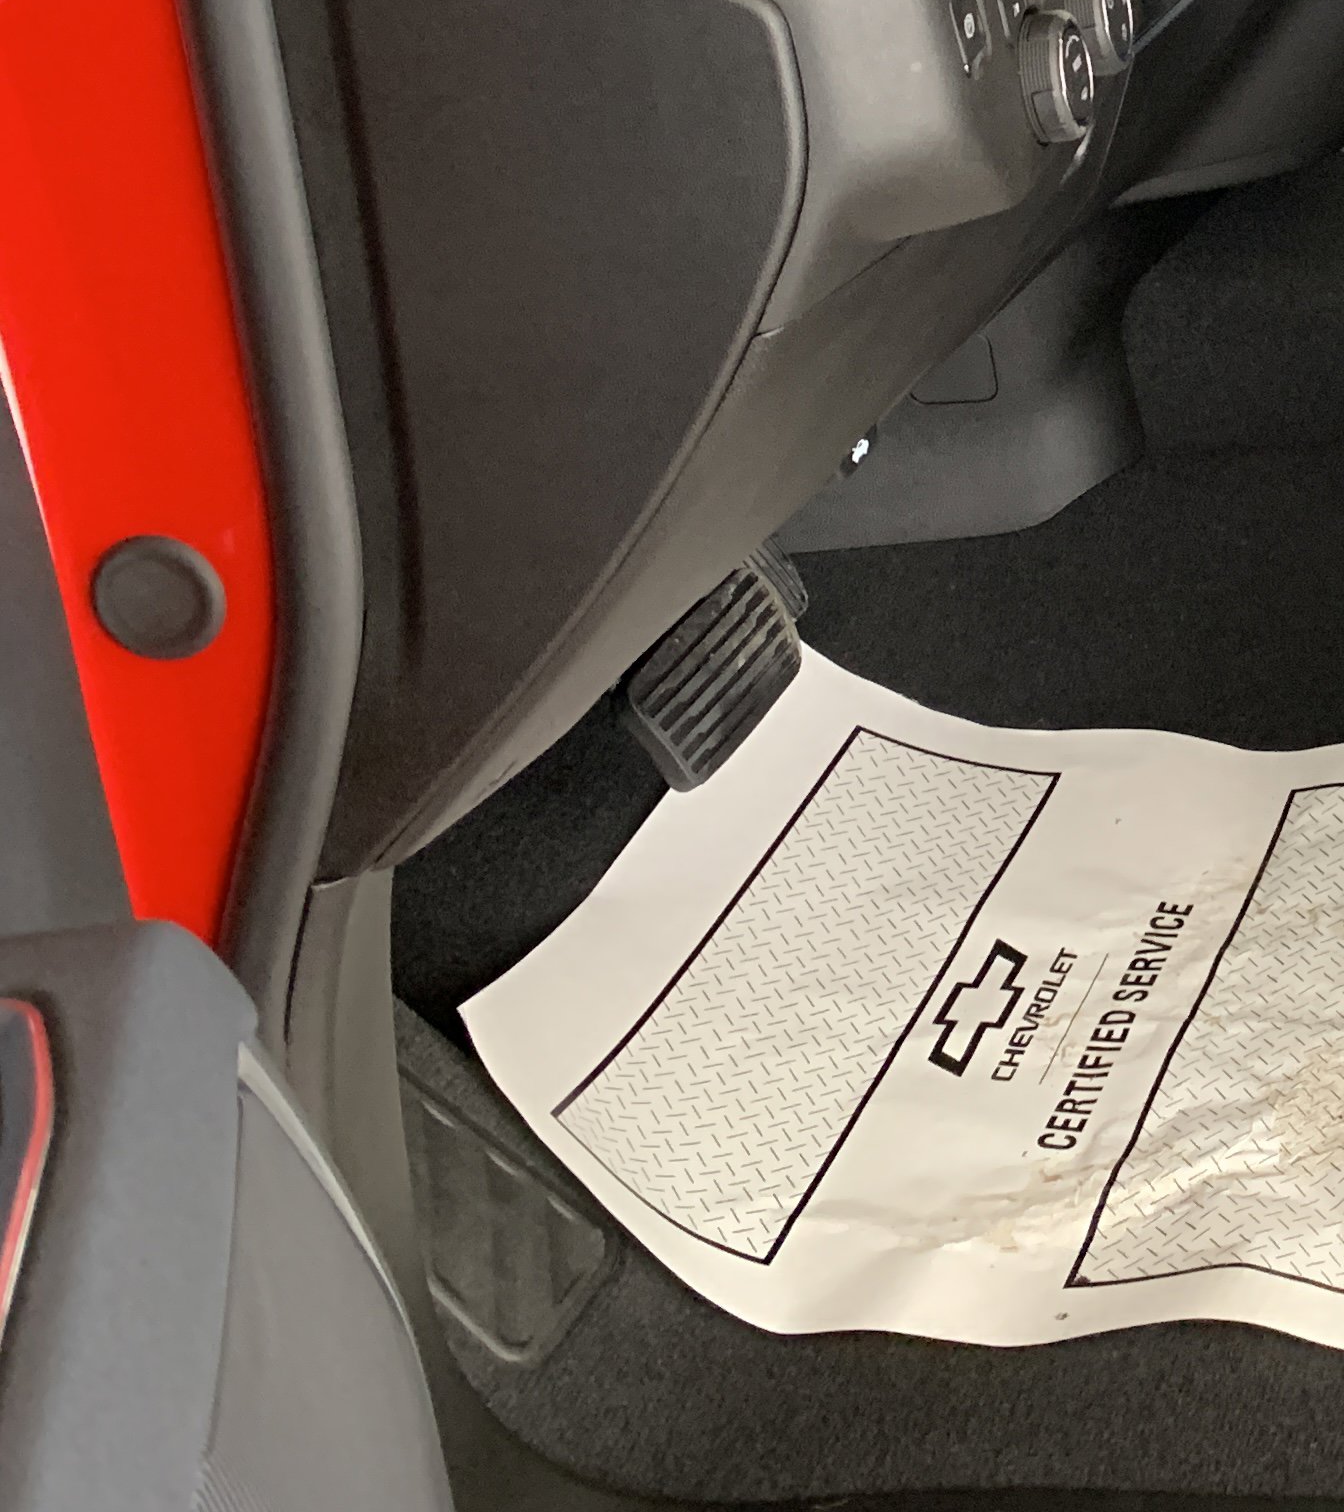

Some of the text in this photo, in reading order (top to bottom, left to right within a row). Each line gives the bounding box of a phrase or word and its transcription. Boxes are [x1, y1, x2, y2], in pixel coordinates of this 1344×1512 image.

[991, 947, 1078, 1082] CHEVROLET
[1037, 901, 1194, 1150] CERTIFIED SERVICE
